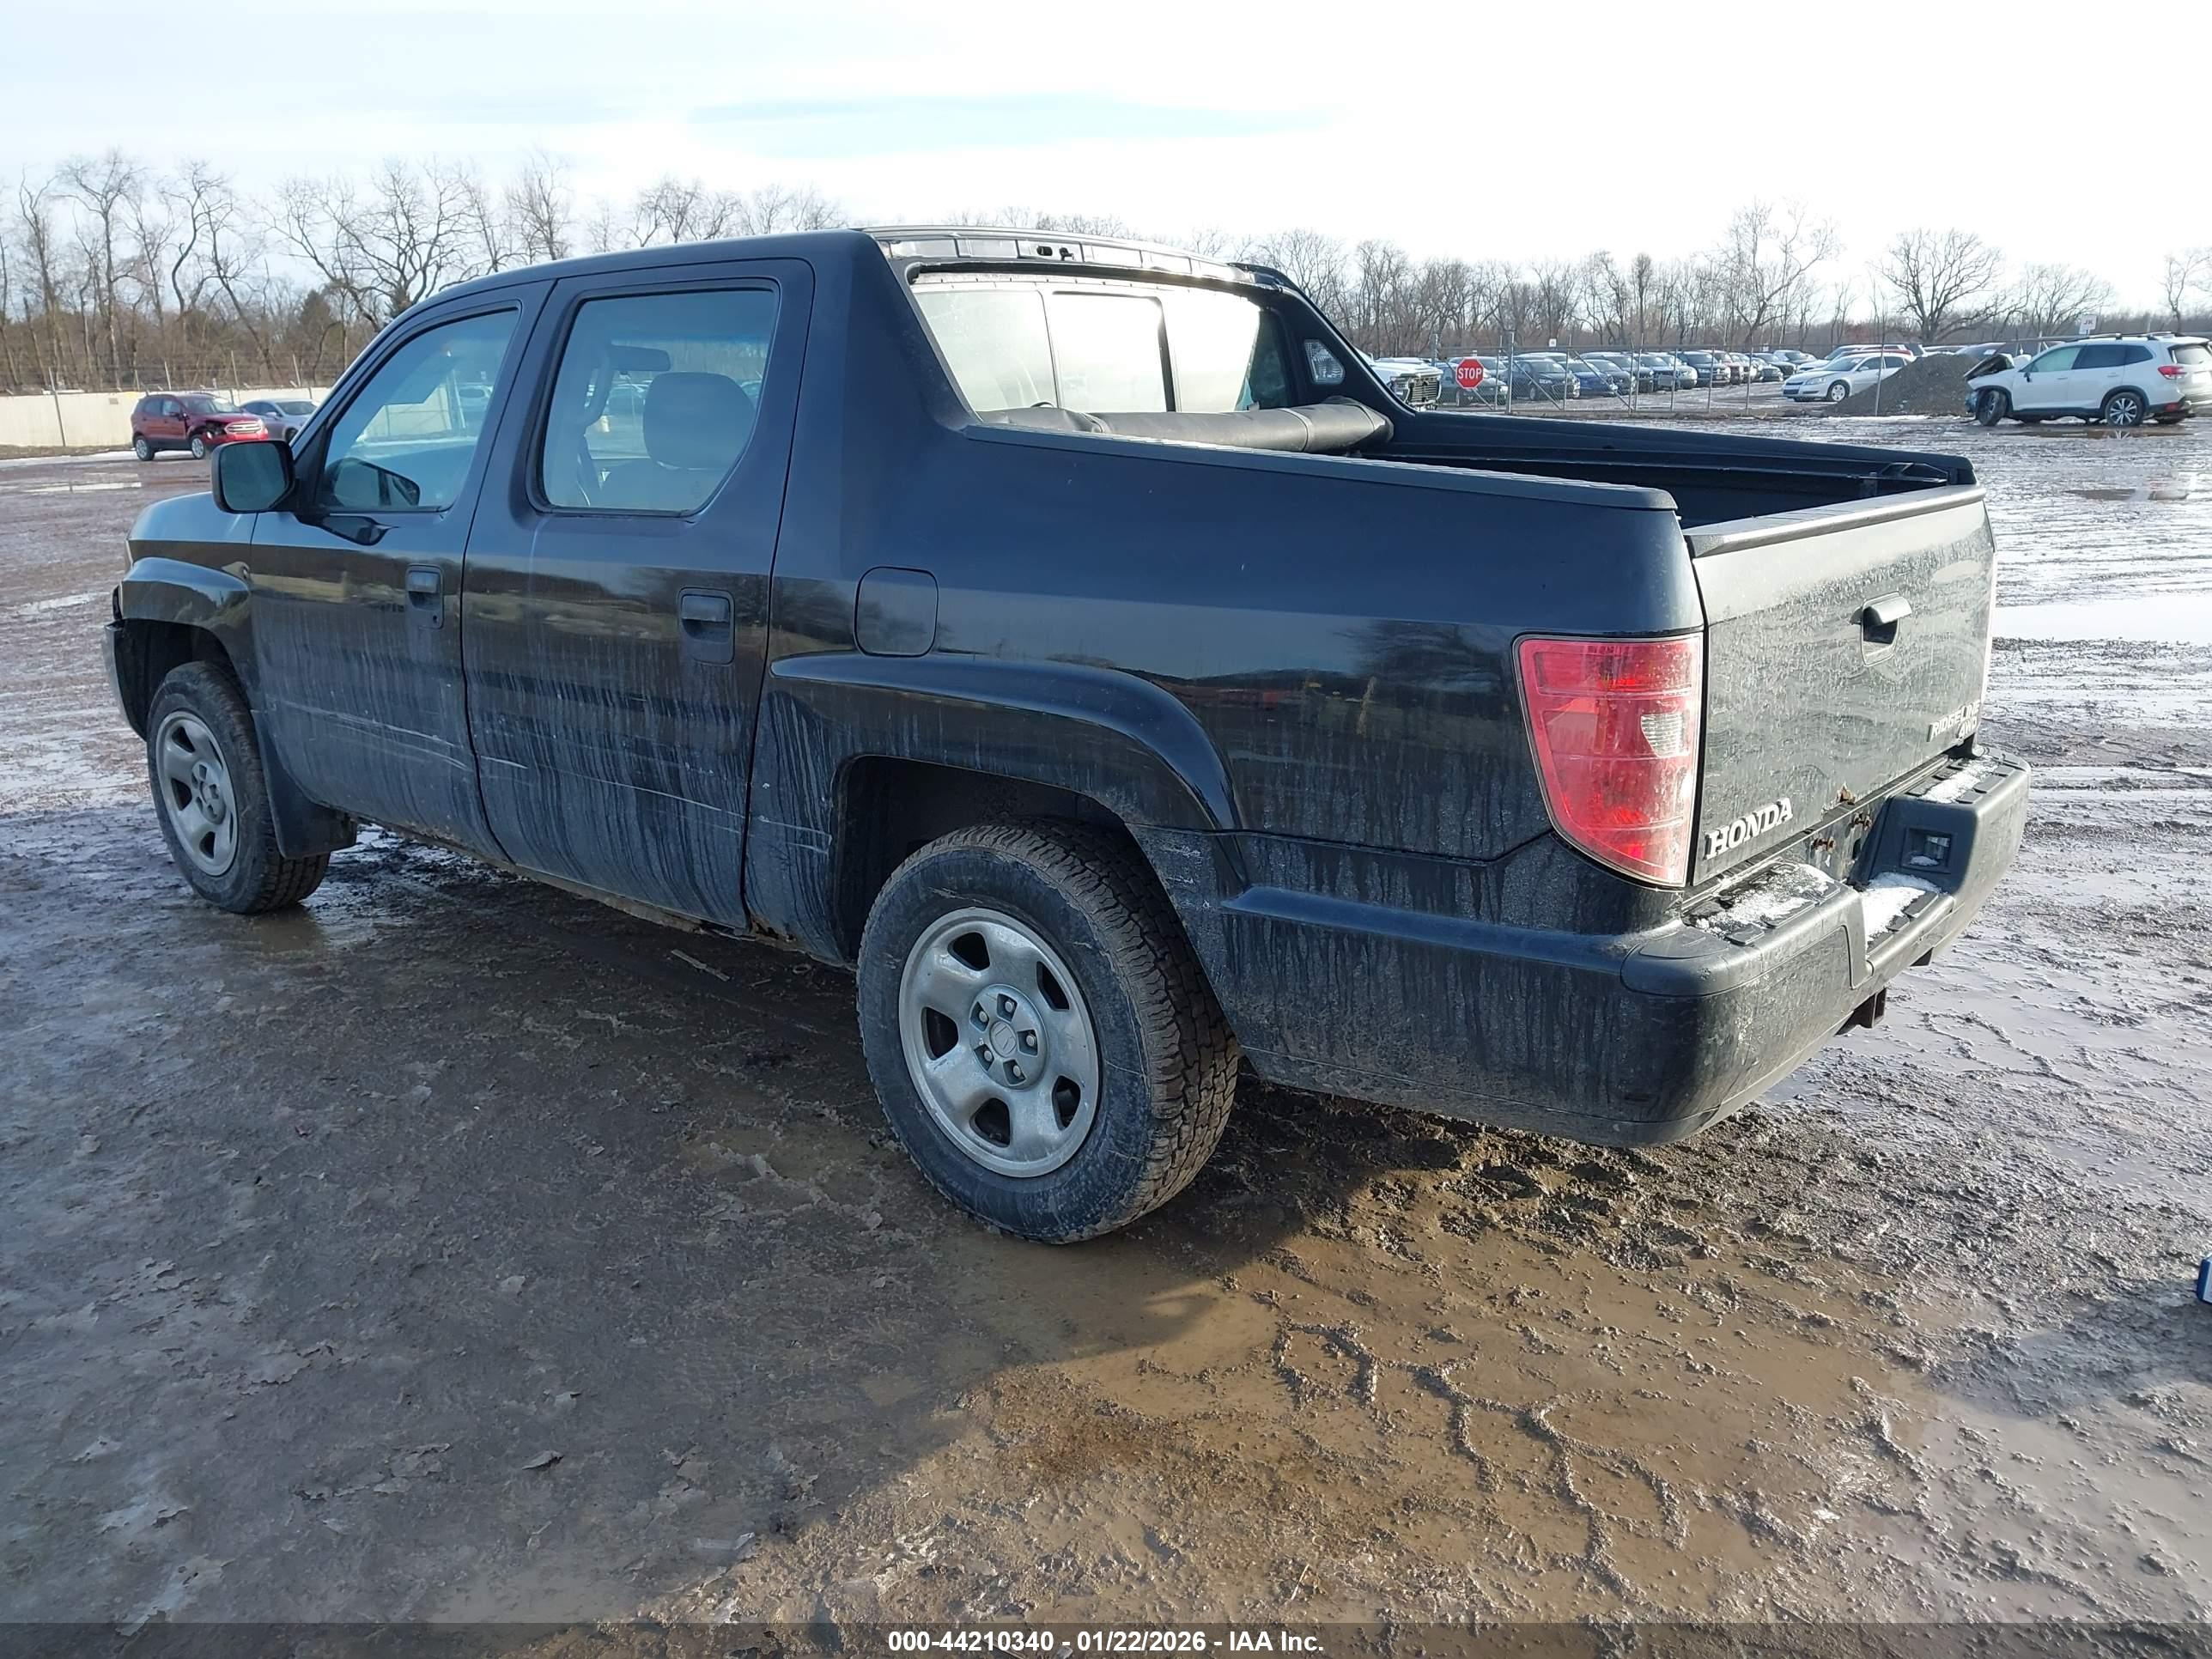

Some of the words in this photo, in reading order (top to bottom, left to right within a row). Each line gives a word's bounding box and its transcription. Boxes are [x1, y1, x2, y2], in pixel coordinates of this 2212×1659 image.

[1458, 368, 1482, 380] STOP
[1927, 700, 1980, 742] RIDGELINE
[1957, 716, 1978, 738] 4WD
[1703, 798, 1793, 860] HONDA
